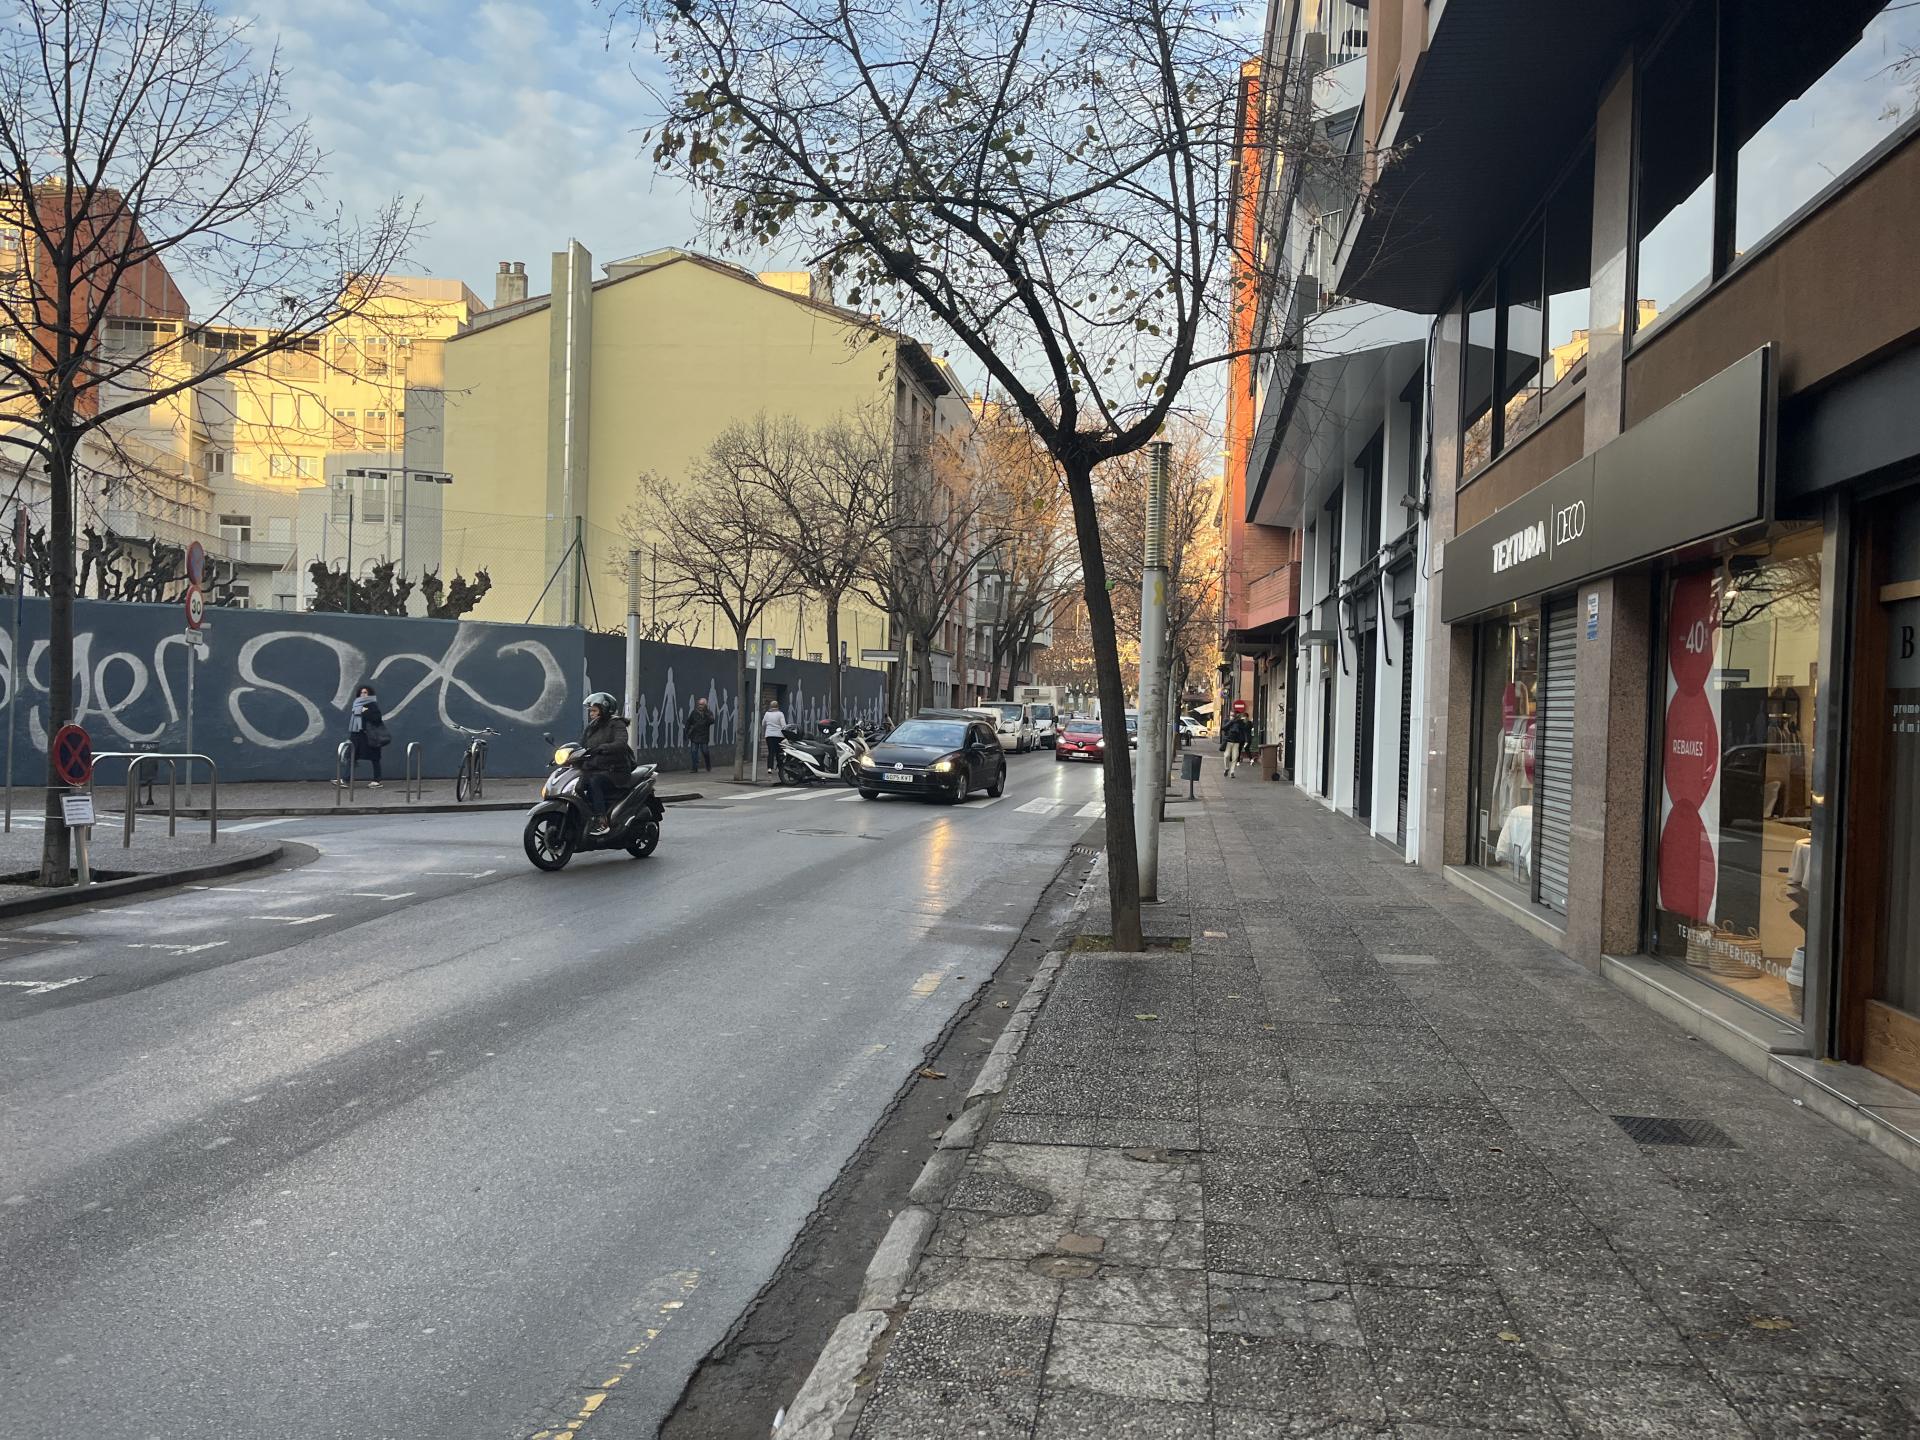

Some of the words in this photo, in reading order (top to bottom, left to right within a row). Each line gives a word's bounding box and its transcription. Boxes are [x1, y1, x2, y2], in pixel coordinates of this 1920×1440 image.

[1492, 520, 1546, 573] TEXTURA
[1556, 500, 1586, 546] DECO
[191, 598, 202, 616] 30
[1672, 739, 1704, 757] REBAIXES
